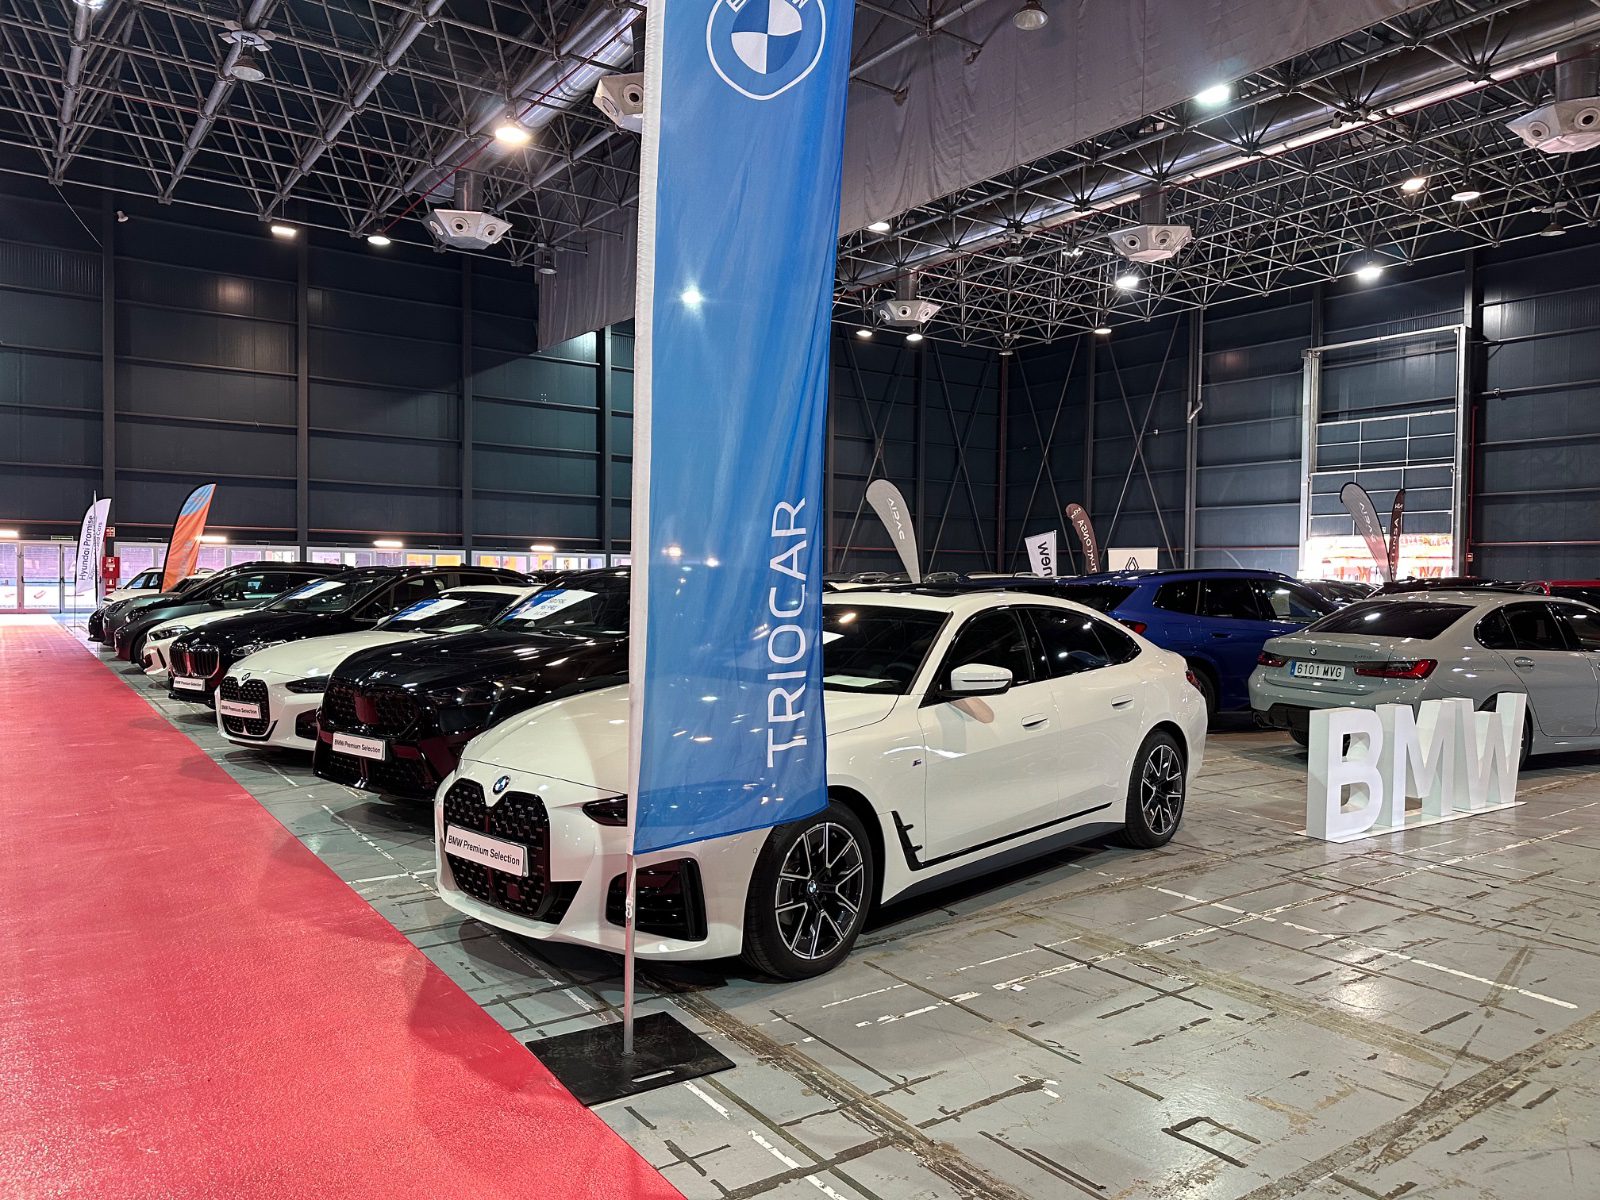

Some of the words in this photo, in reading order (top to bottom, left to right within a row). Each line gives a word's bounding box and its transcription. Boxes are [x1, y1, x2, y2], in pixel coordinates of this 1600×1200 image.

[84, 515, 94, 547] Promise
[79, 547, 90, 581] Hyundai
[767, 497, 807, 767] TRIOCAR
[1297, 664, 1320, 676] 6101
[1322, 666, 1342, 678] MVG
[345, 740, 361, 750] Premium
[361, 743, 381, 754] Selection
[1306, 693, 1527, 840] BMW
[448, 835, 464, 848] BMW
[463, 840, 489, 857] Premium
[489, 848, 520, 866] Selection
